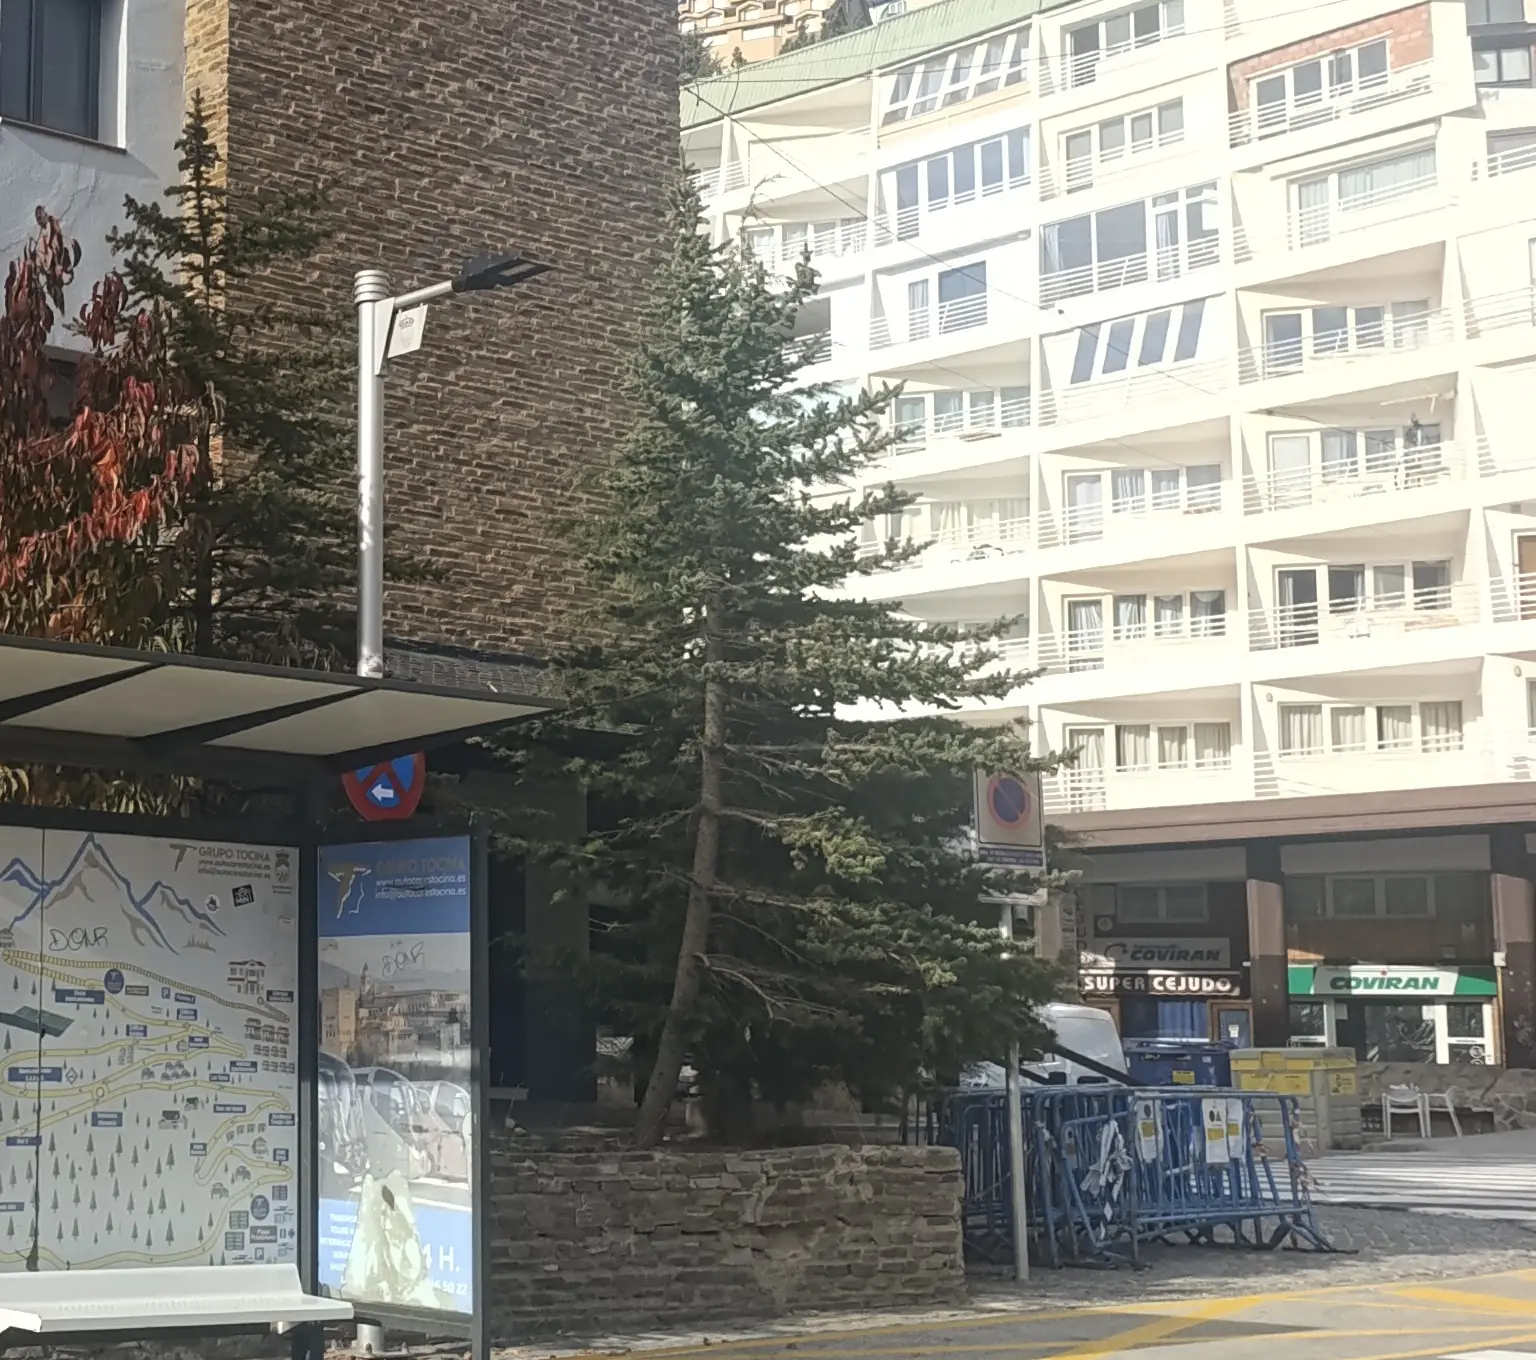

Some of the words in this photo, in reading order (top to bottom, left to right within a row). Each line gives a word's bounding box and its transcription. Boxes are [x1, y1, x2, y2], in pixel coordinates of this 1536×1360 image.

[198, 846, 233, 859] GRUPO
[236, 849, 270, 862] TOCINA
[420, 856, 465, 873] TOCINA
[1130, 949, 1222, 961] COVIRAN
[1084, 976, 1146, 990] SUPER
[1152, 976, 1232, 991] CEJUDO
[1330, 976, 1440, 990] COVIRAN
